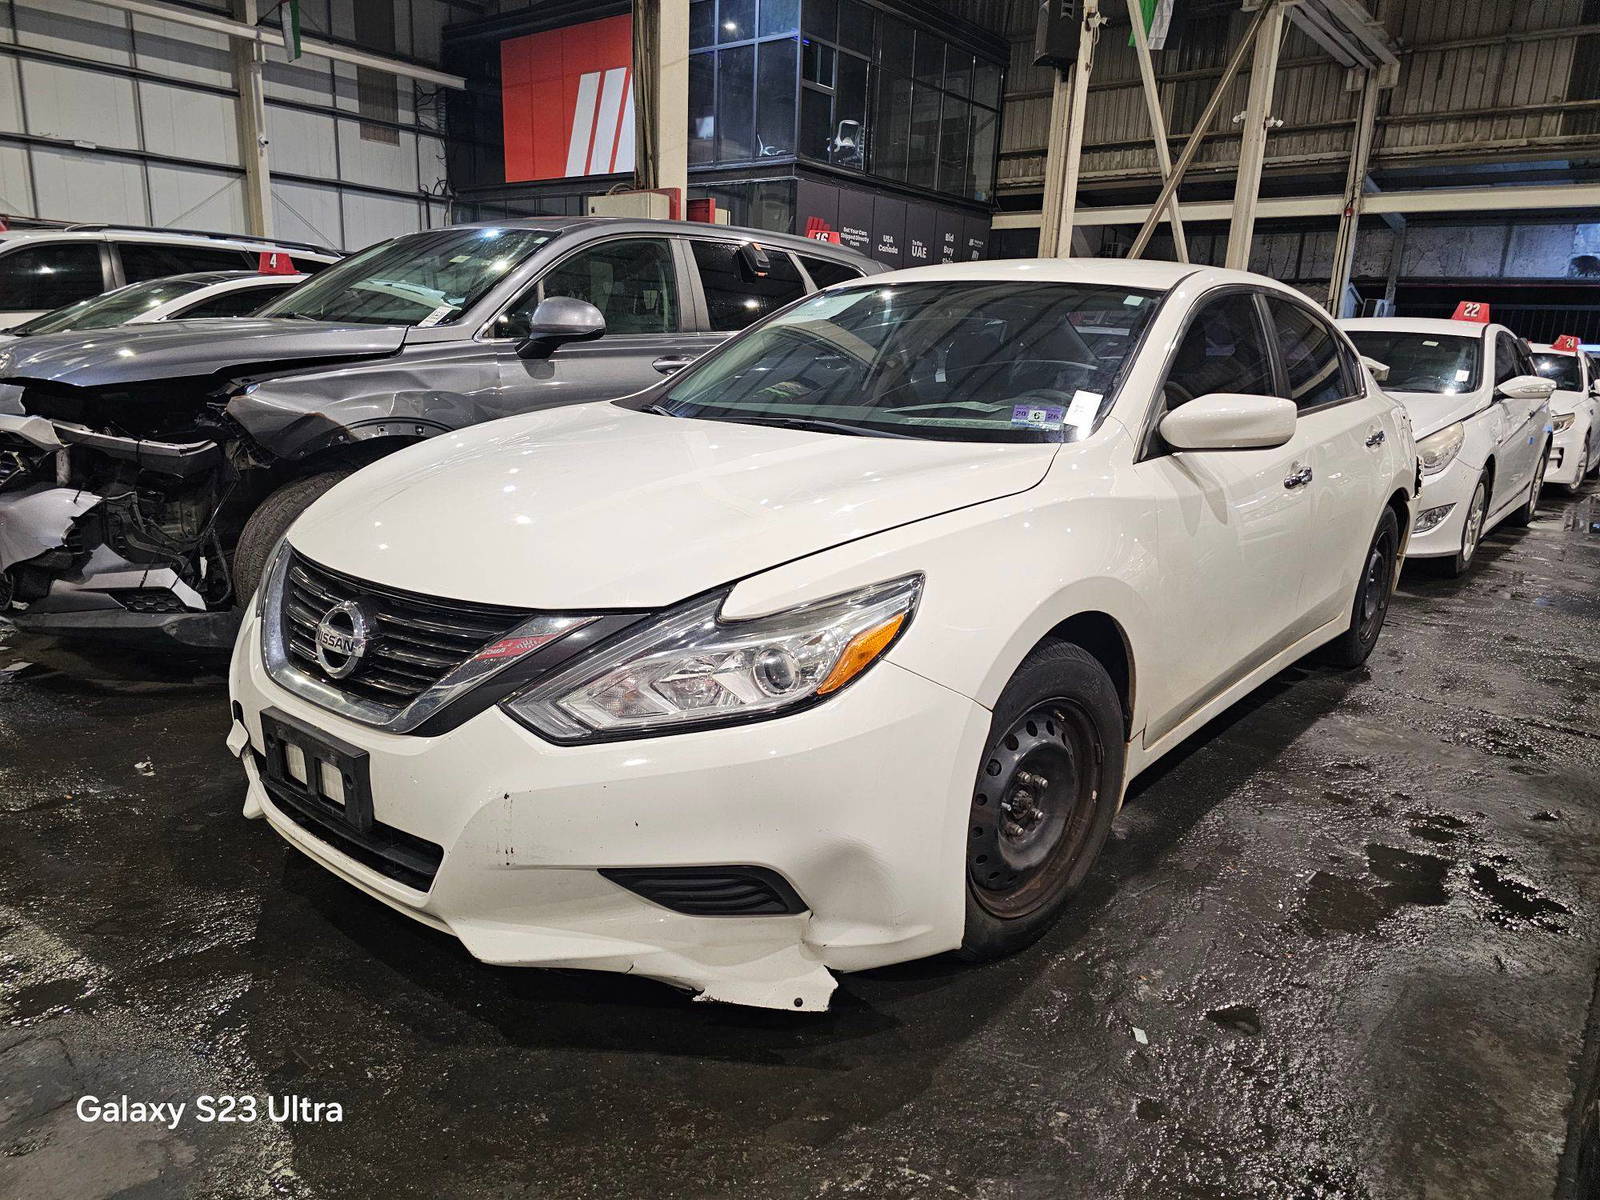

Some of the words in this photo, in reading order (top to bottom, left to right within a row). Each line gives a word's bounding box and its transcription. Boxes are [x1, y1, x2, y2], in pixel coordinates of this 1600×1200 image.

[883, 235, 893, 243] USA
[945, 233, 954, 242] Bid
[879, 244, 898, 254] Canada
[912, 246, 927, 258] UAE
[944, 246, 954, 256] Buy
[270, 254, 277, 268] 4
[1464, 302, 1480, 318] 22
[1566, 338, 1574, 348] 24
[1034, 412, 1040, 420] 6
